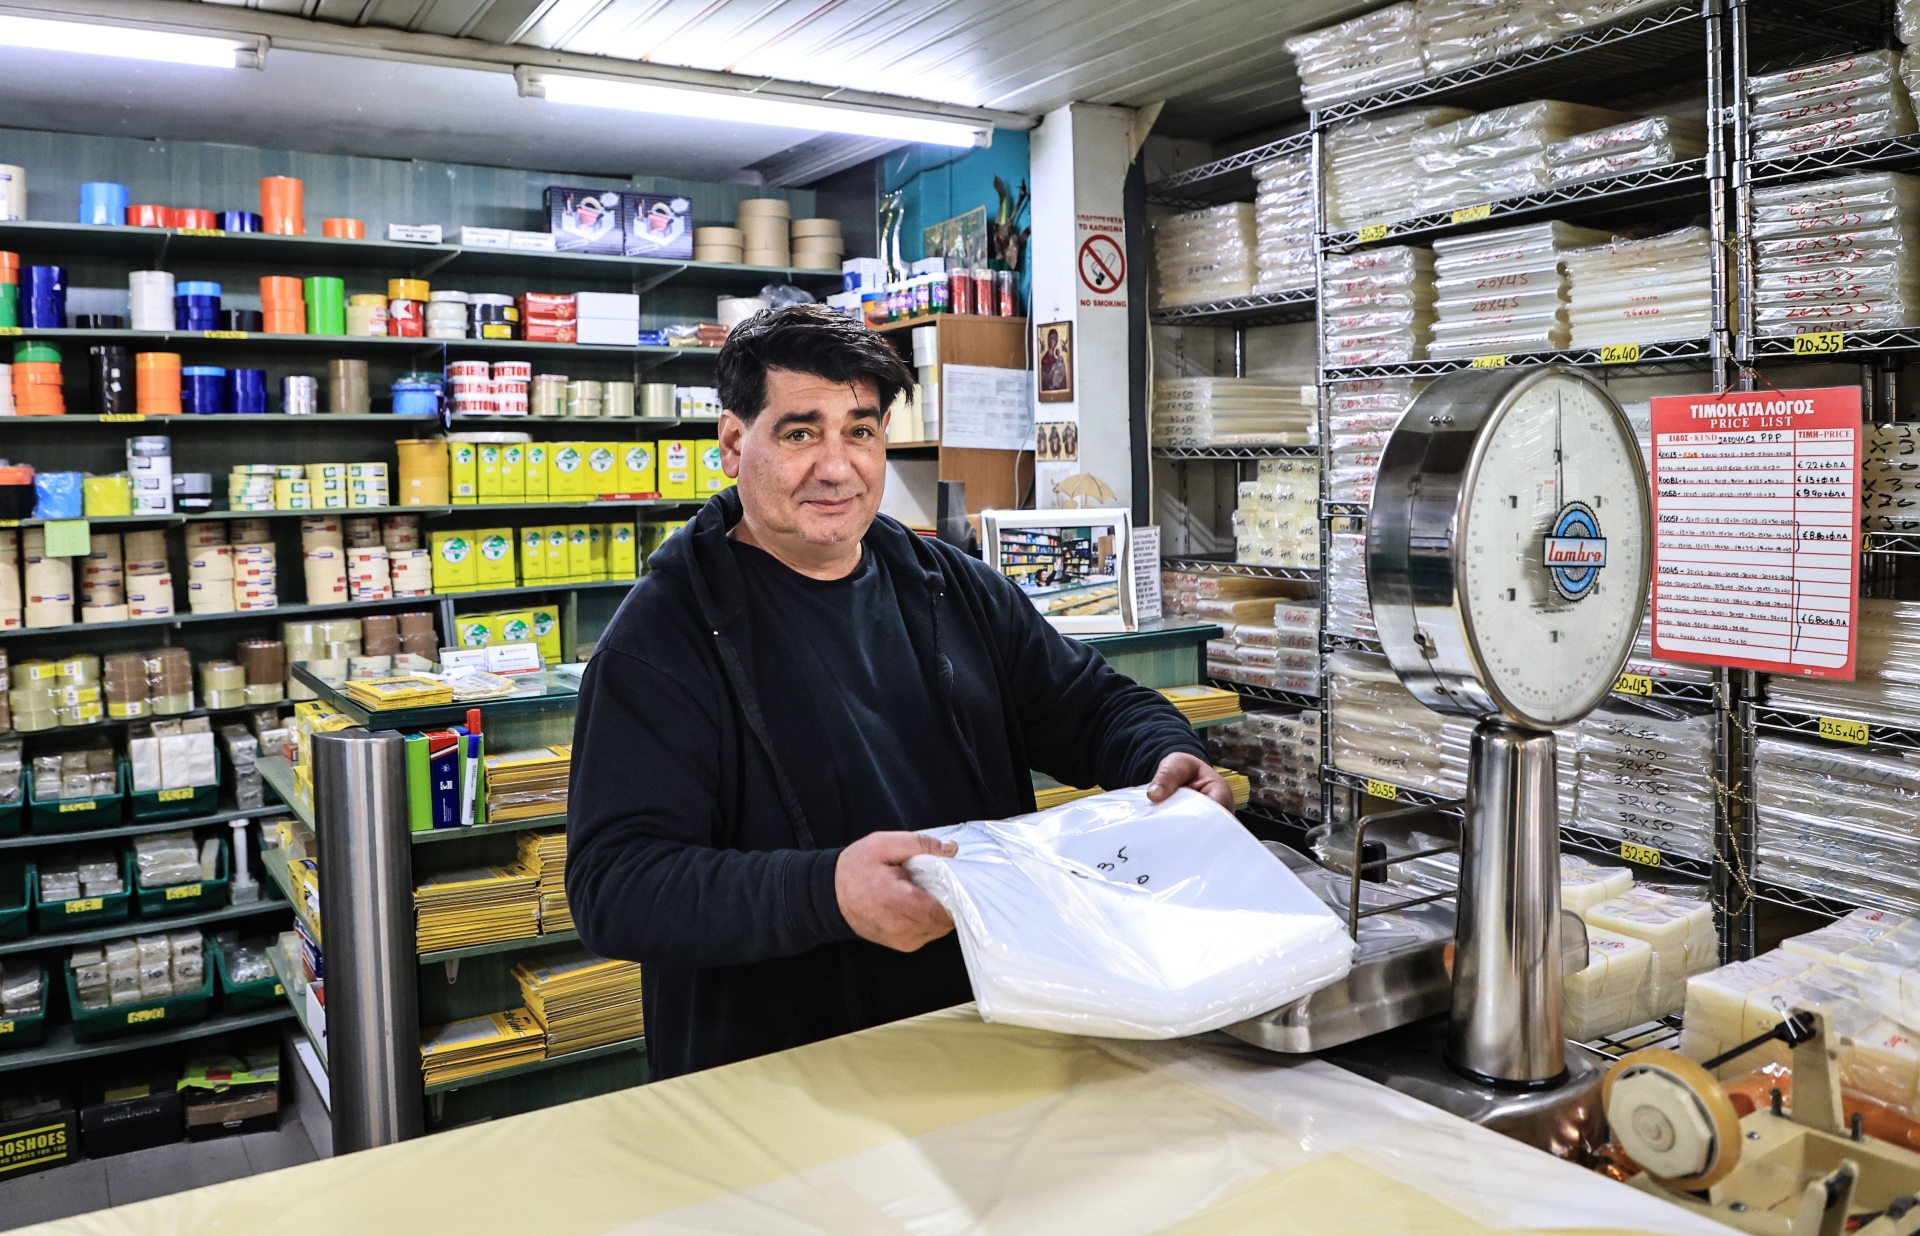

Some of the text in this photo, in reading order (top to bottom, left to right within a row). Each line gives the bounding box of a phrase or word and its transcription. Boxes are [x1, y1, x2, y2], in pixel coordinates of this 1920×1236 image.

[1780, 96, 1855, 118] 20x35
[1780, 232, 1859, 252] 20x35
[1796, 334, 1840, 352] 20x35
[1603, 346, 1636, 360] 26x40
[1690, 400, 1814, 418] ΤΙΜΟΚΑΤΑΛΟΓΟΣ
[1710, 416, 1794, 428] PRICE LIST
[1618, 794, 1676, 814] 32x50
[1620, 812, 1674, 831] 32x50
[1621, 828, 1672, 851] 32x50
[1624, 846, 1660, 865] 32x50
[13, 1152, 35, 1162] SHOES
[37, 1148, 50, 1156] FOR
[54, 1144, 66, 1152] YOU
